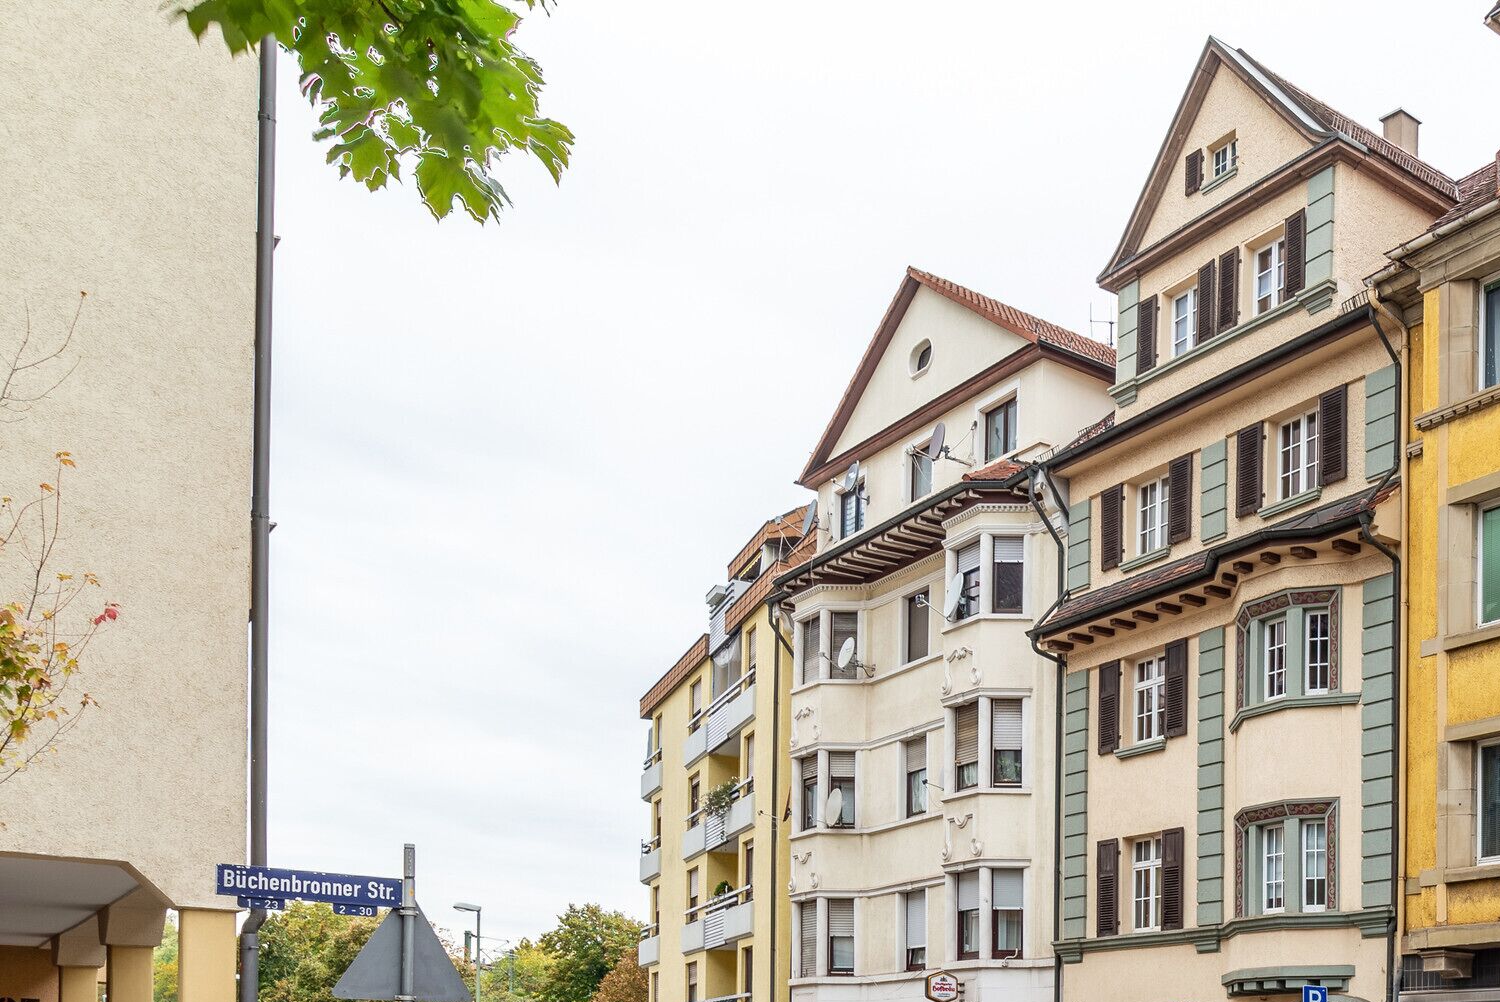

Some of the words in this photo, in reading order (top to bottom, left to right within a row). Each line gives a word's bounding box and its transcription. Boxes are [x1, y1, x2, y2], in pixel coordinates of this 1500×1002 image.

[223, 869, 362, 897] Büchenbronner
[367, 881, 395, 900] Str.
[264, 900, 279, 910] 23
[339, 906, 346, 914] 2
[359, 907, 373, 916] 30
[866, 926, 908, 939] Westliche
[842, 940, 933, 958] Karl-Friedrich-Straße
